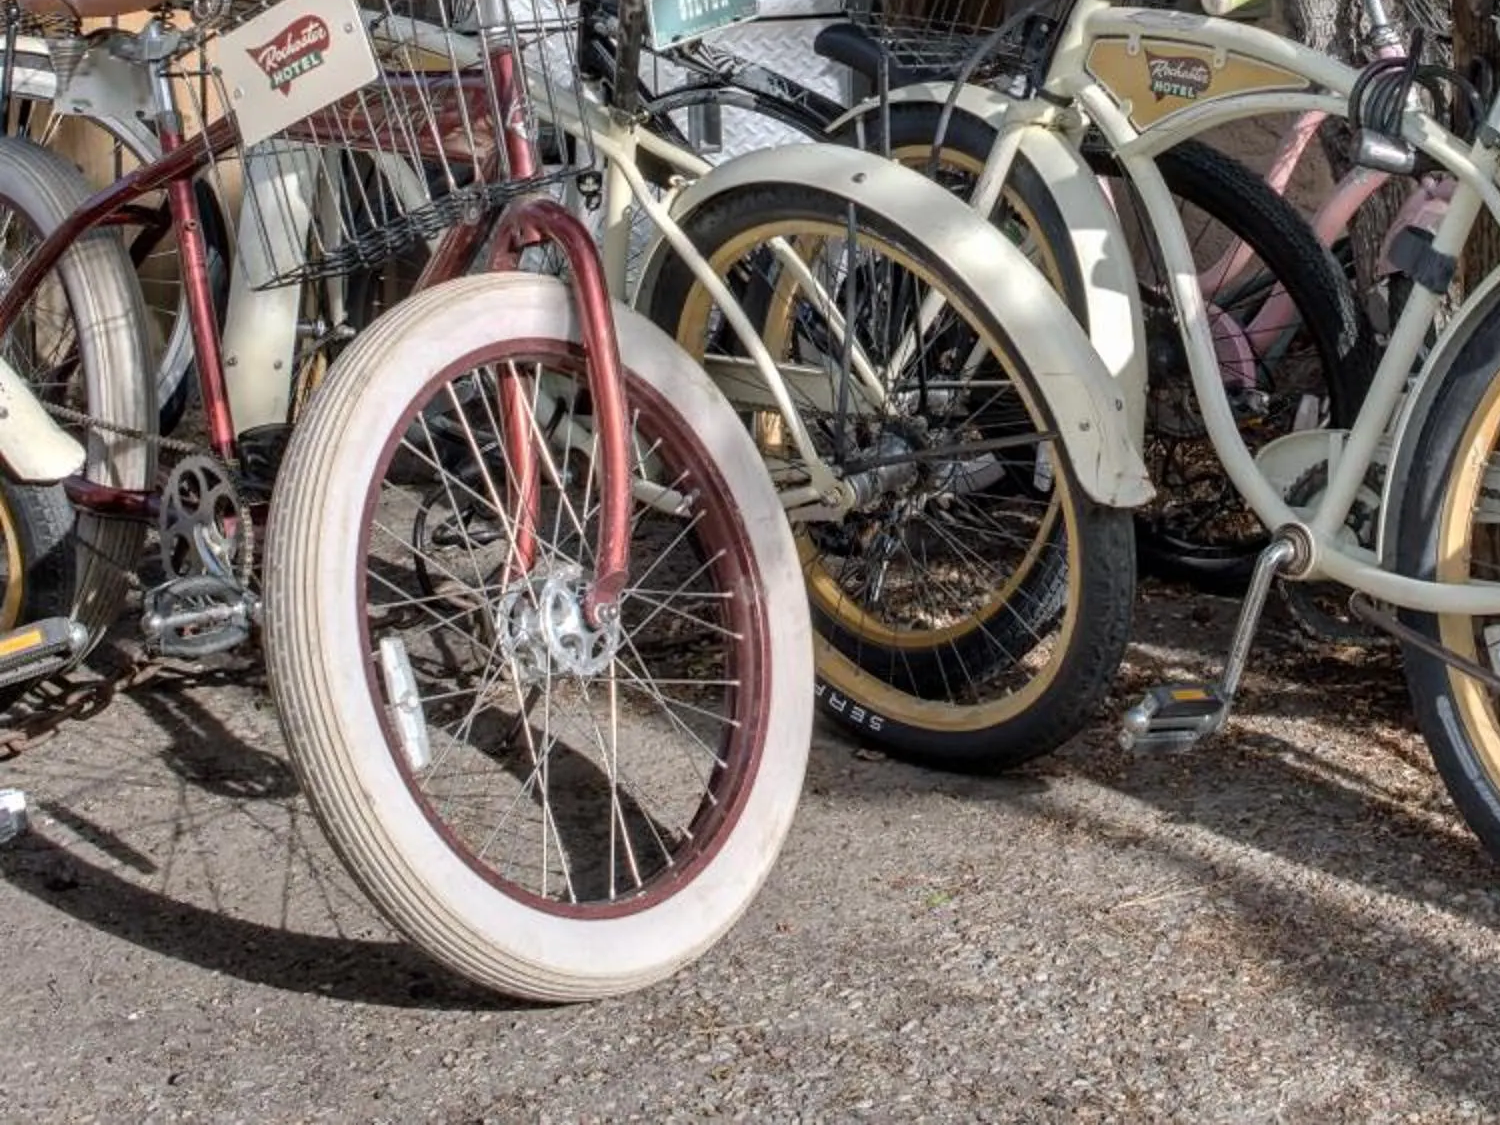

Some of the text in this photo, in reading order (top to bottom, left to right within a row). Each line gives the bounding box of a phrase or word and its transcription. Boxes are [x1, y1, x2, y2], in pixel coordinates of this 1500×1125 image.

[259, 22, 326, 72] Rochester
[273, 53, 320, 85] HOTEL
[1150, 59, 1208, 83] Rochester
[1154, 81, 1195, 98] HOTEL
